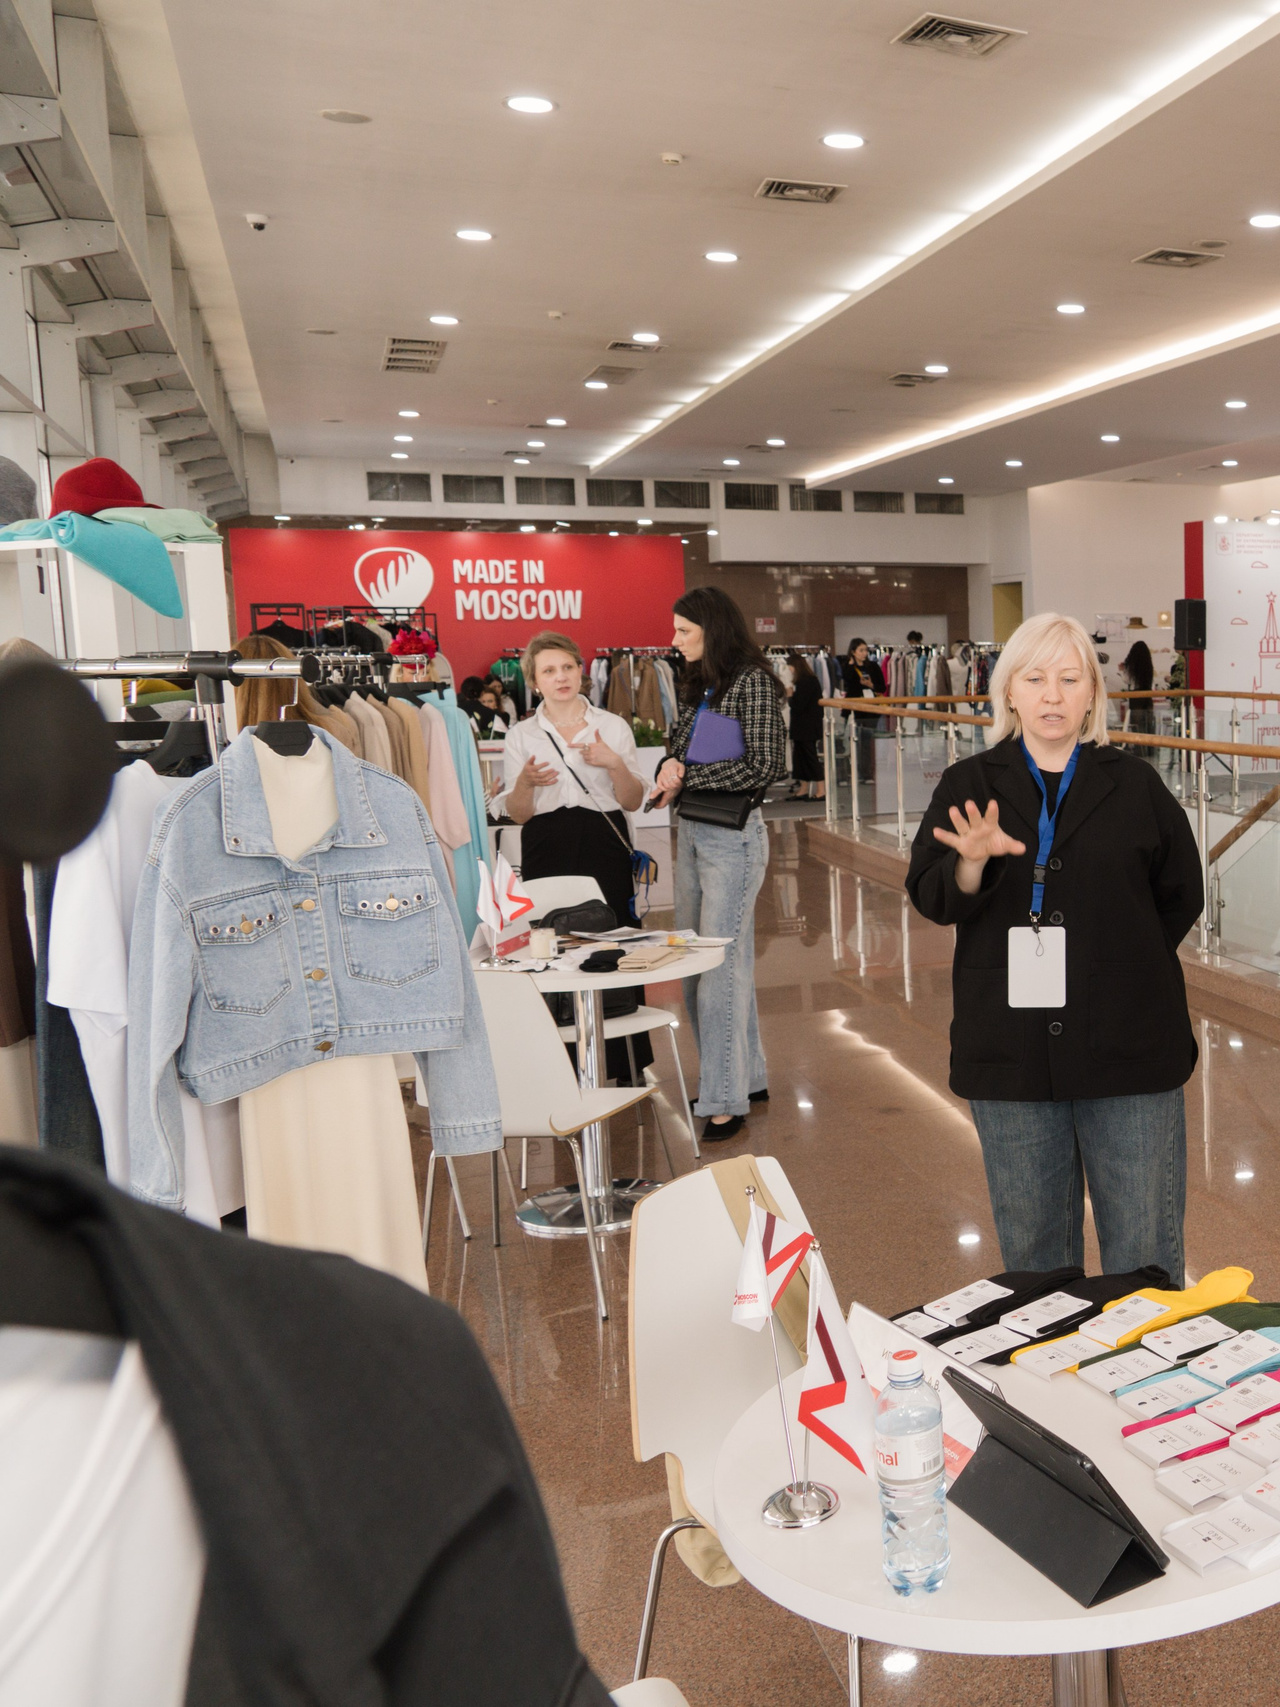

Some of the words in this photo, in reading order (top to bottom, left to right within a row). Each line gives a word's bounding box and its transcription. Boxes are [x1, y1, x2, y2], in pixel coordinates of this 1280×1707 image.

[453, 559, 518, 584] MADE
[522, 559, 545, 584] IN
[455, 589, 582, 621] MOSCOW
